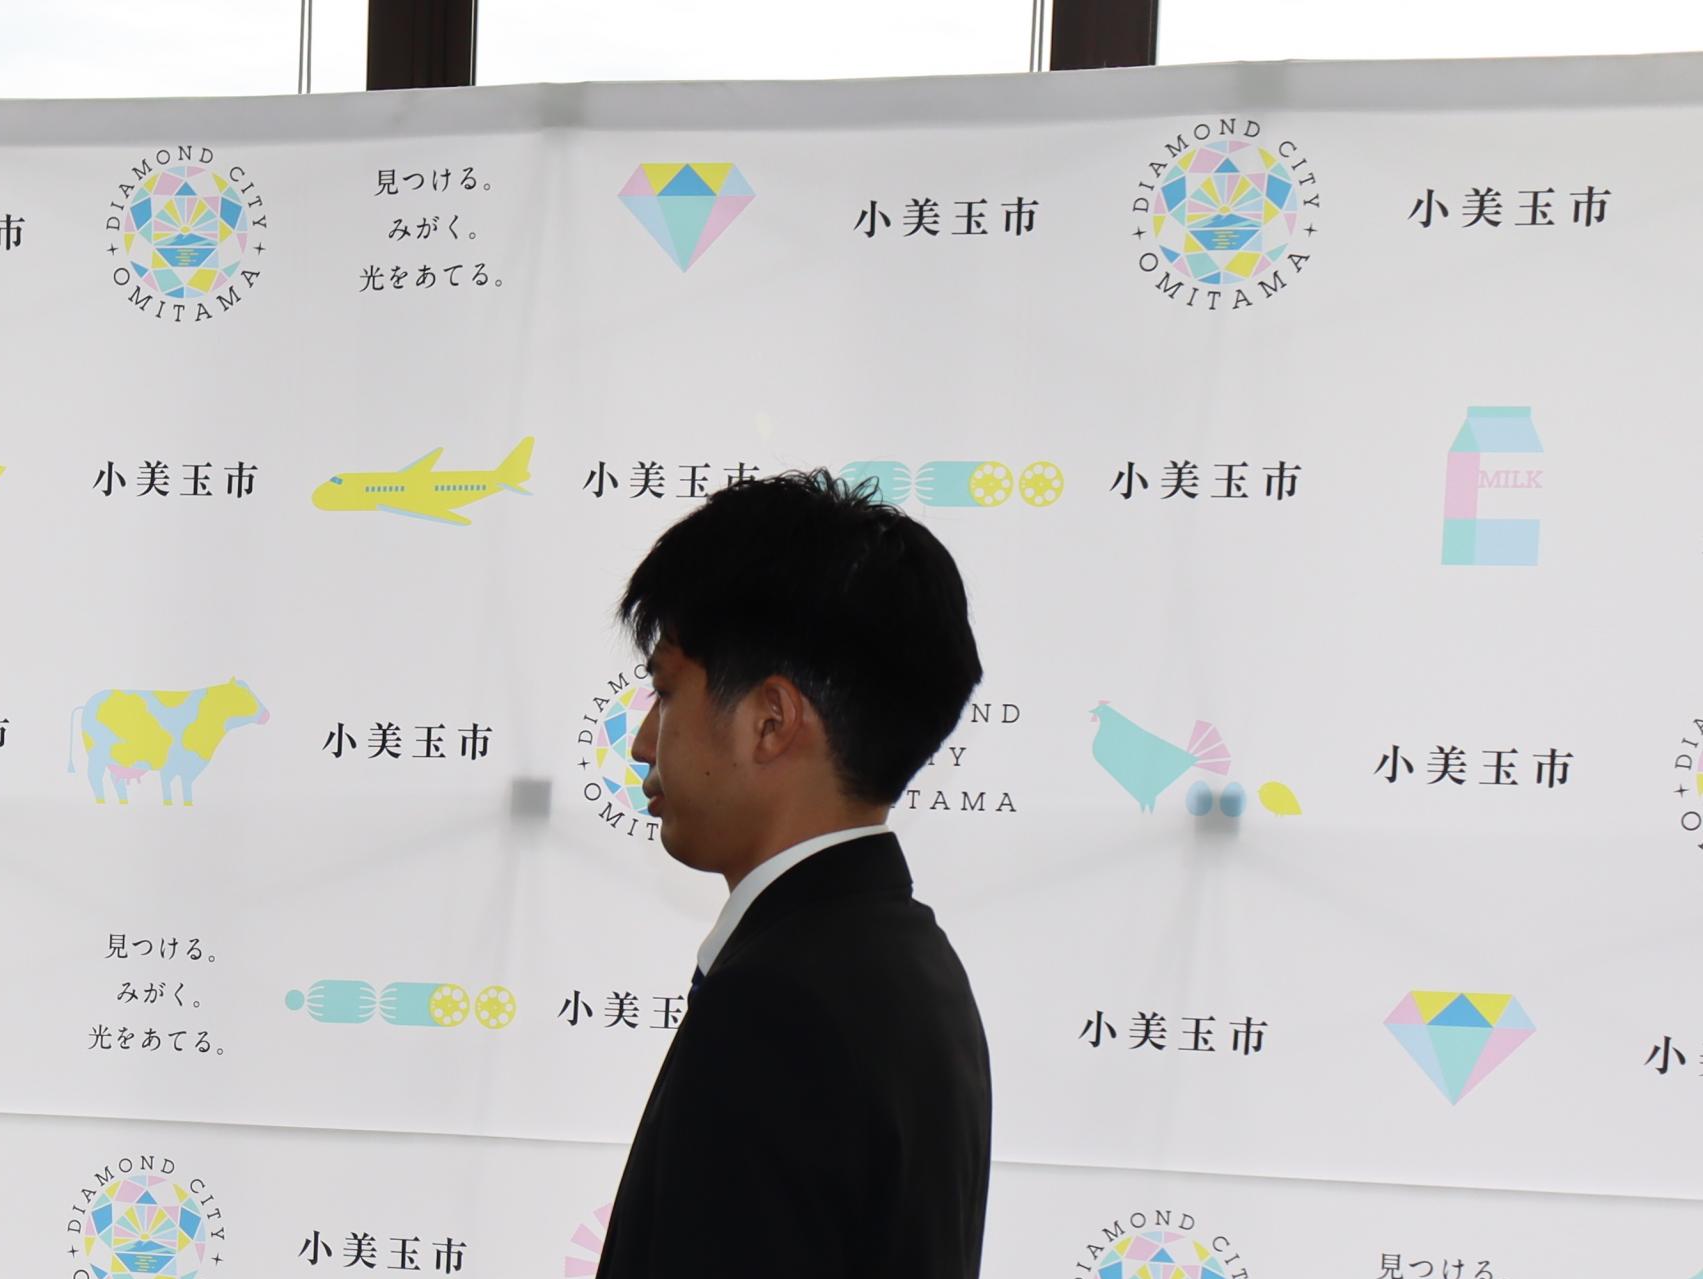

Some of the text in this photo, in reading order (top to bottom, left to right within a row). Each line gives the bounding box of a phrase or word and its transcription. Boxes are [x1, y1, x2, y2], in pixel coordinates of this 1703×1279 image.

[374, 166, 492, 197] 見つける。
[1132, 118, 1321, 213] DIAMOND CITY
[106, 145, 267, 231] DIAMOND CITY
[1407, 185, 1612, 229] 小美玉市
[388, 214, 477, 242] みがく。
[853, 196, 1040, 239] 小美玉市
[113, 267, 261, 322] OMITAMA
[359, 262, 504, 293] 光をあてる。
[1139, 252, 1311, 311] OMITAMA
[92, 459, 259, 499] 小美玉市
[1109, 459, 1302, 501] 小美玉市
[1478, 469, 1545, 489] MILK
[578, 663, 650, 745] DIAMO
[322, 721, 493, 761] 小美玉市
[1373, 744, 1575, 789] 小美玉市
[583, 782, 660, 841] OMIT
[906, 789, 1017, 813] TAMA
[104, 933, 217, 963] 見つける。
[116, 981, 202, 1009] みがく。
[557, 989, 686, 1030] 小美玉
[87, 1023, 225, 1056] 光をあてる。
[1078, 1009, 1269, 1056] 小美玉市
[1644, 1035, 1703, 1075] 小
[67, 1155, 226, 1241] DIAMOND CITY
[298, 1229, 468, 1275] 小美玉市
